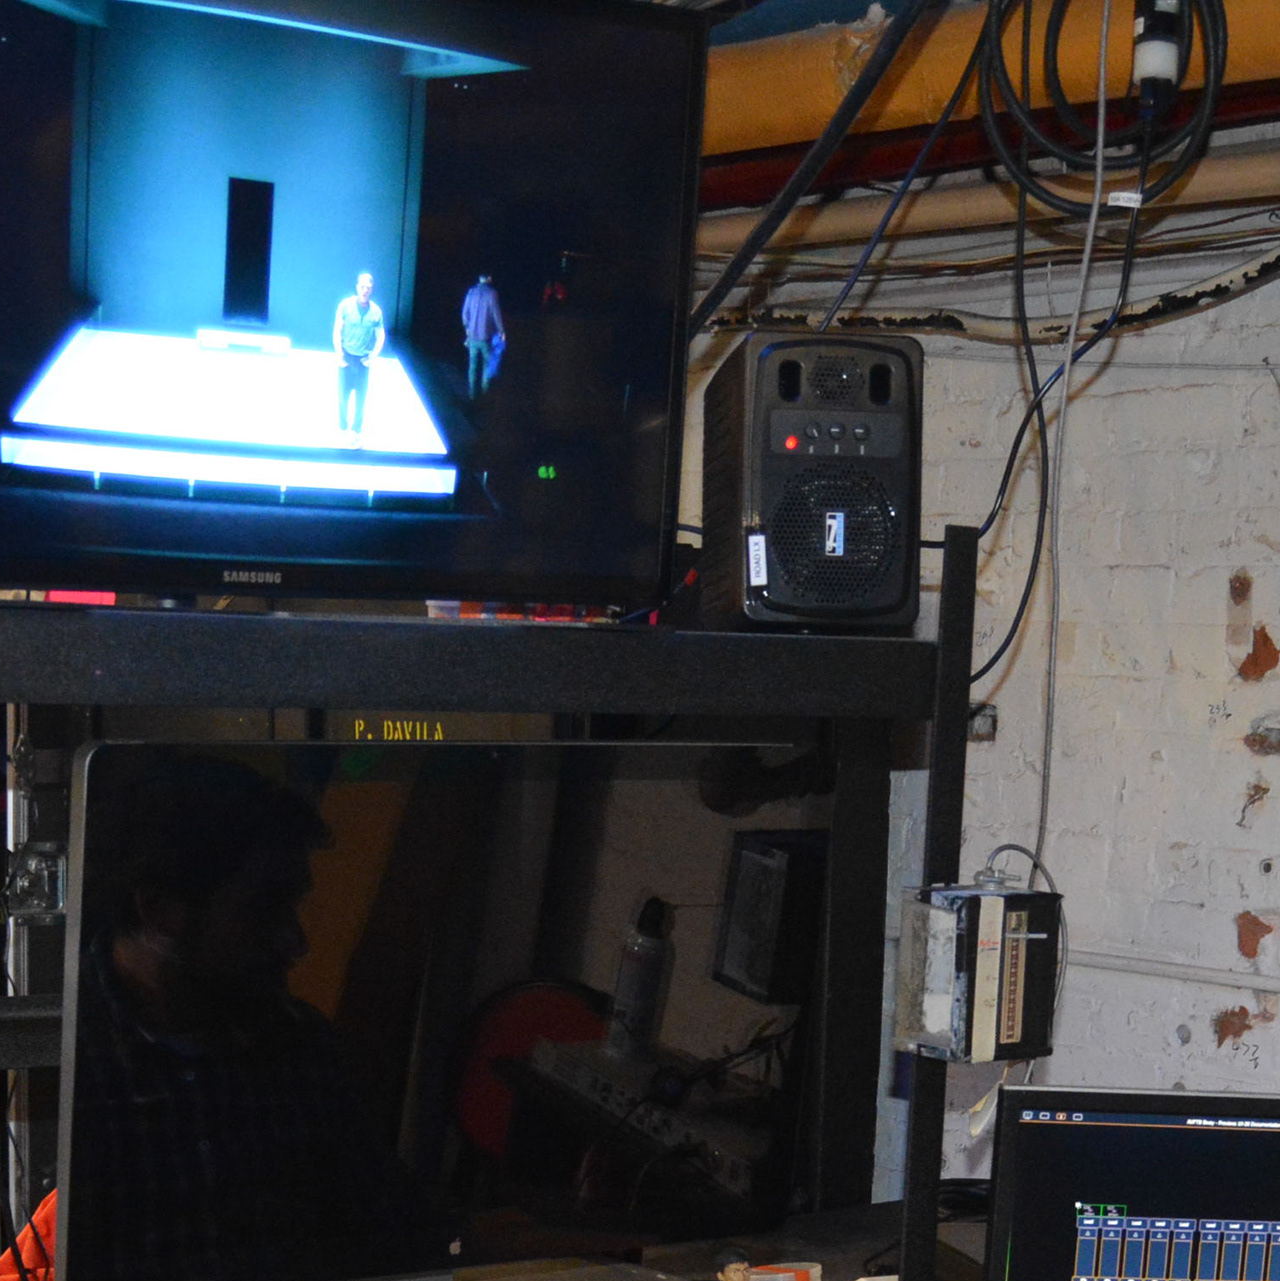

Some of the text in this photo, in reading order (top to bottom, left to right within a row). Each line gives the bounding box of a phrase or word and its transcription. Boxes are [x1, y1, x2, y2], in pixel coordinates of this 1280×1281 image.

[223, 570, 282, 583] SAMSUNG
[355, 719, 443, 740] P. DAVILA
